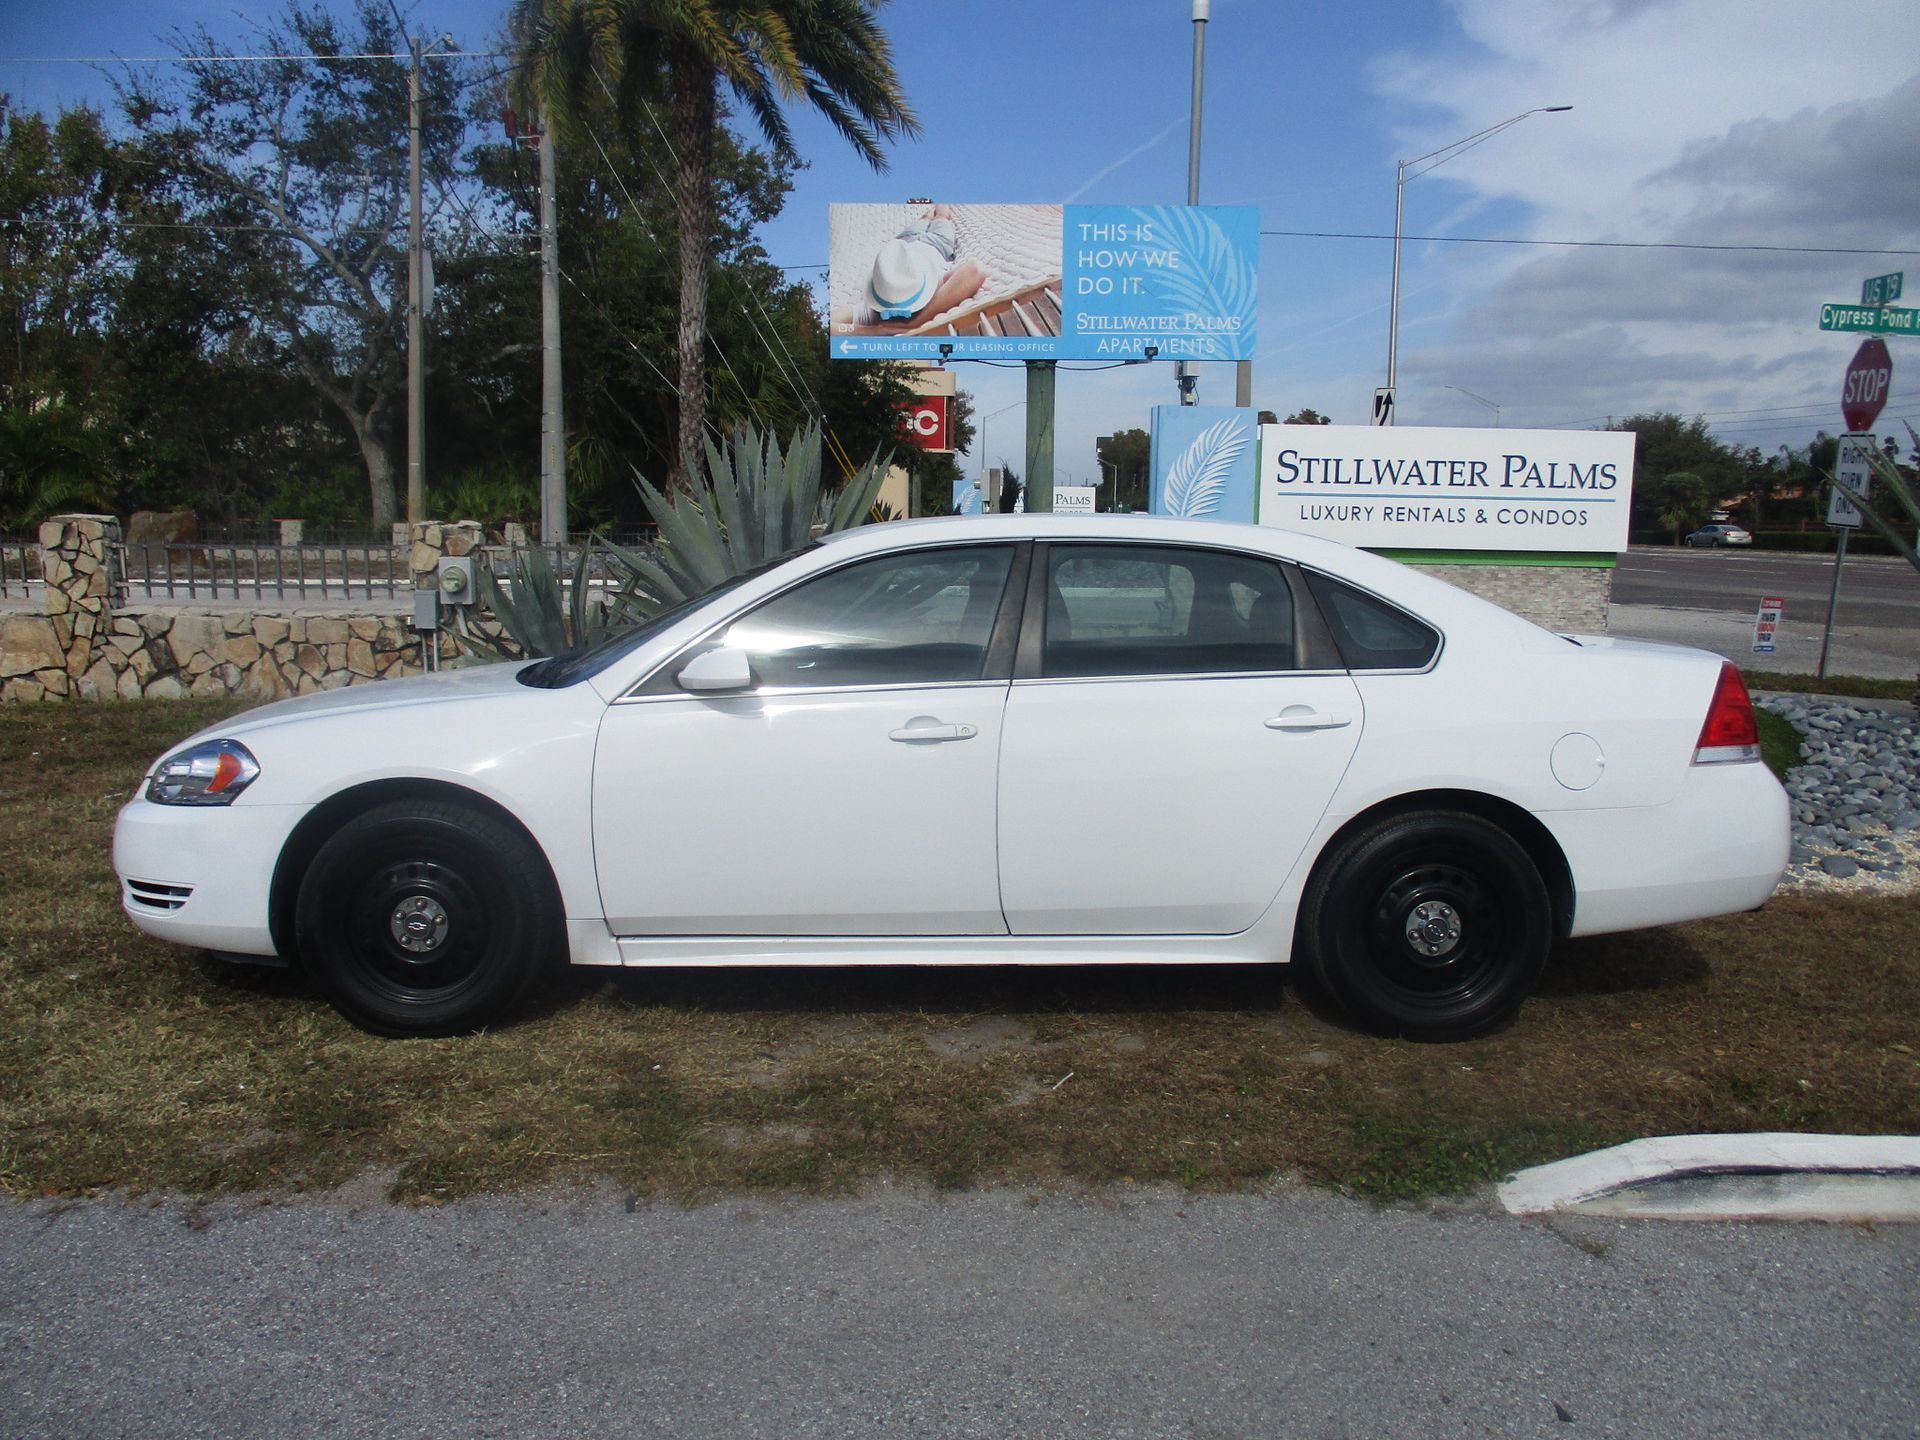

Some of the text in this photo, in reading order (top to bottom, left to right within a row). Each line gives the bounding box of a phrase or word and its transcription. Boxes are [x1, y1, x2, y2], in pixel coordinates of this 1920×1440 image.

[1078, 223, 1153, 241] THIS IS
[1078, 250, 1180, 269] HOW WE
[1078, 277, 1145, 295] DO IT.
[1076, 312, 1241, 330] STILLWATER PALMS
[1821, 305, 1875, 329] Cypress
[1880, 308, 1912, 328] Pond
[862, 343, 1055, 353] TURN LEFT TO UR LEASING OFFICE
[1096, 338, 1217, 354] APARTMENTS
[1845, 368, 1888, 403] STOP
[1276, 449, 1617, 490] STILLWATER PALMS
[1055, 493, 1092, 505] PALMS
[1300, 504, 1588, 526] LUXURY RENTALS & CONDOS
